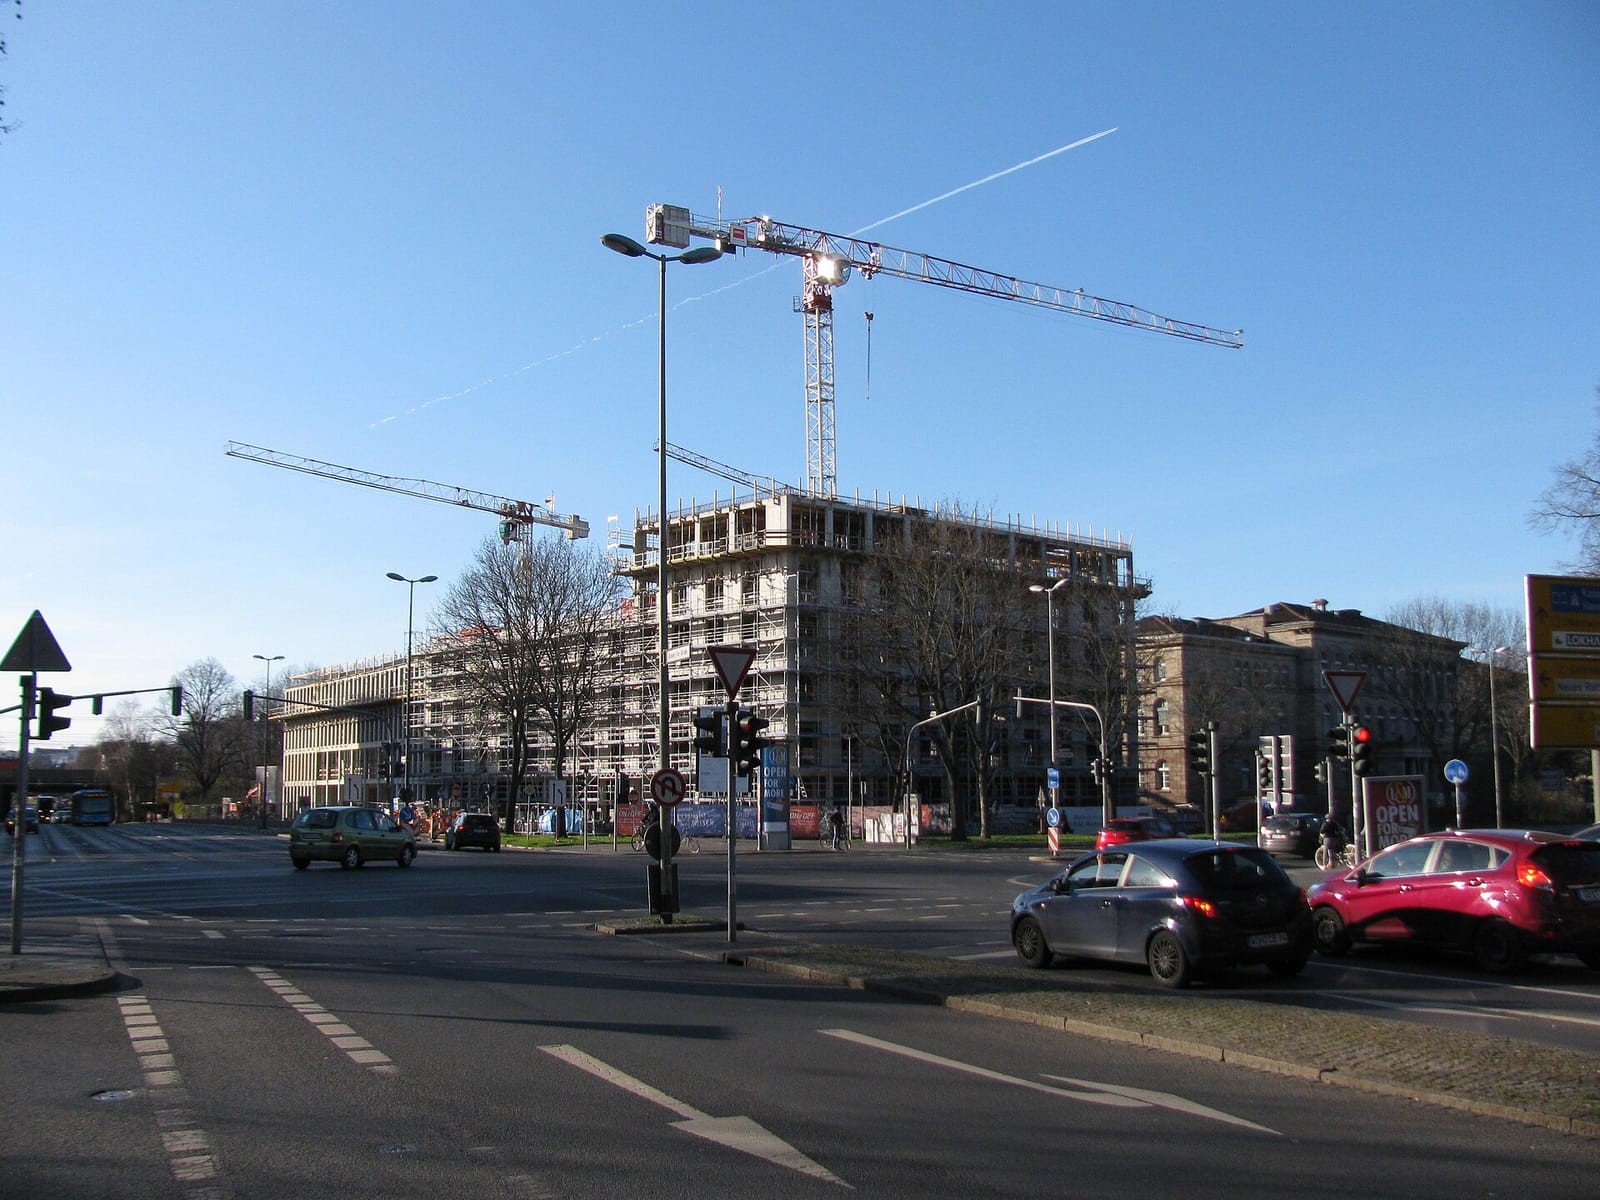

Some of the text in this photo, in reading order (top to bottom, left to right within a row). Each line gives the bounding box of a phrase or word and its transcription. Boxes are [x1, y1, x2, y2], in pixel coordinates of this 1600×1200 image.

[764, 767, 786, 777] OPEN
[764, 778, 779, 788] FOR
[764, 789, 785, 799] MORE
[1376, 805, 1419, 823] OPEN
[1377, 823, 1399, 835] FOR
